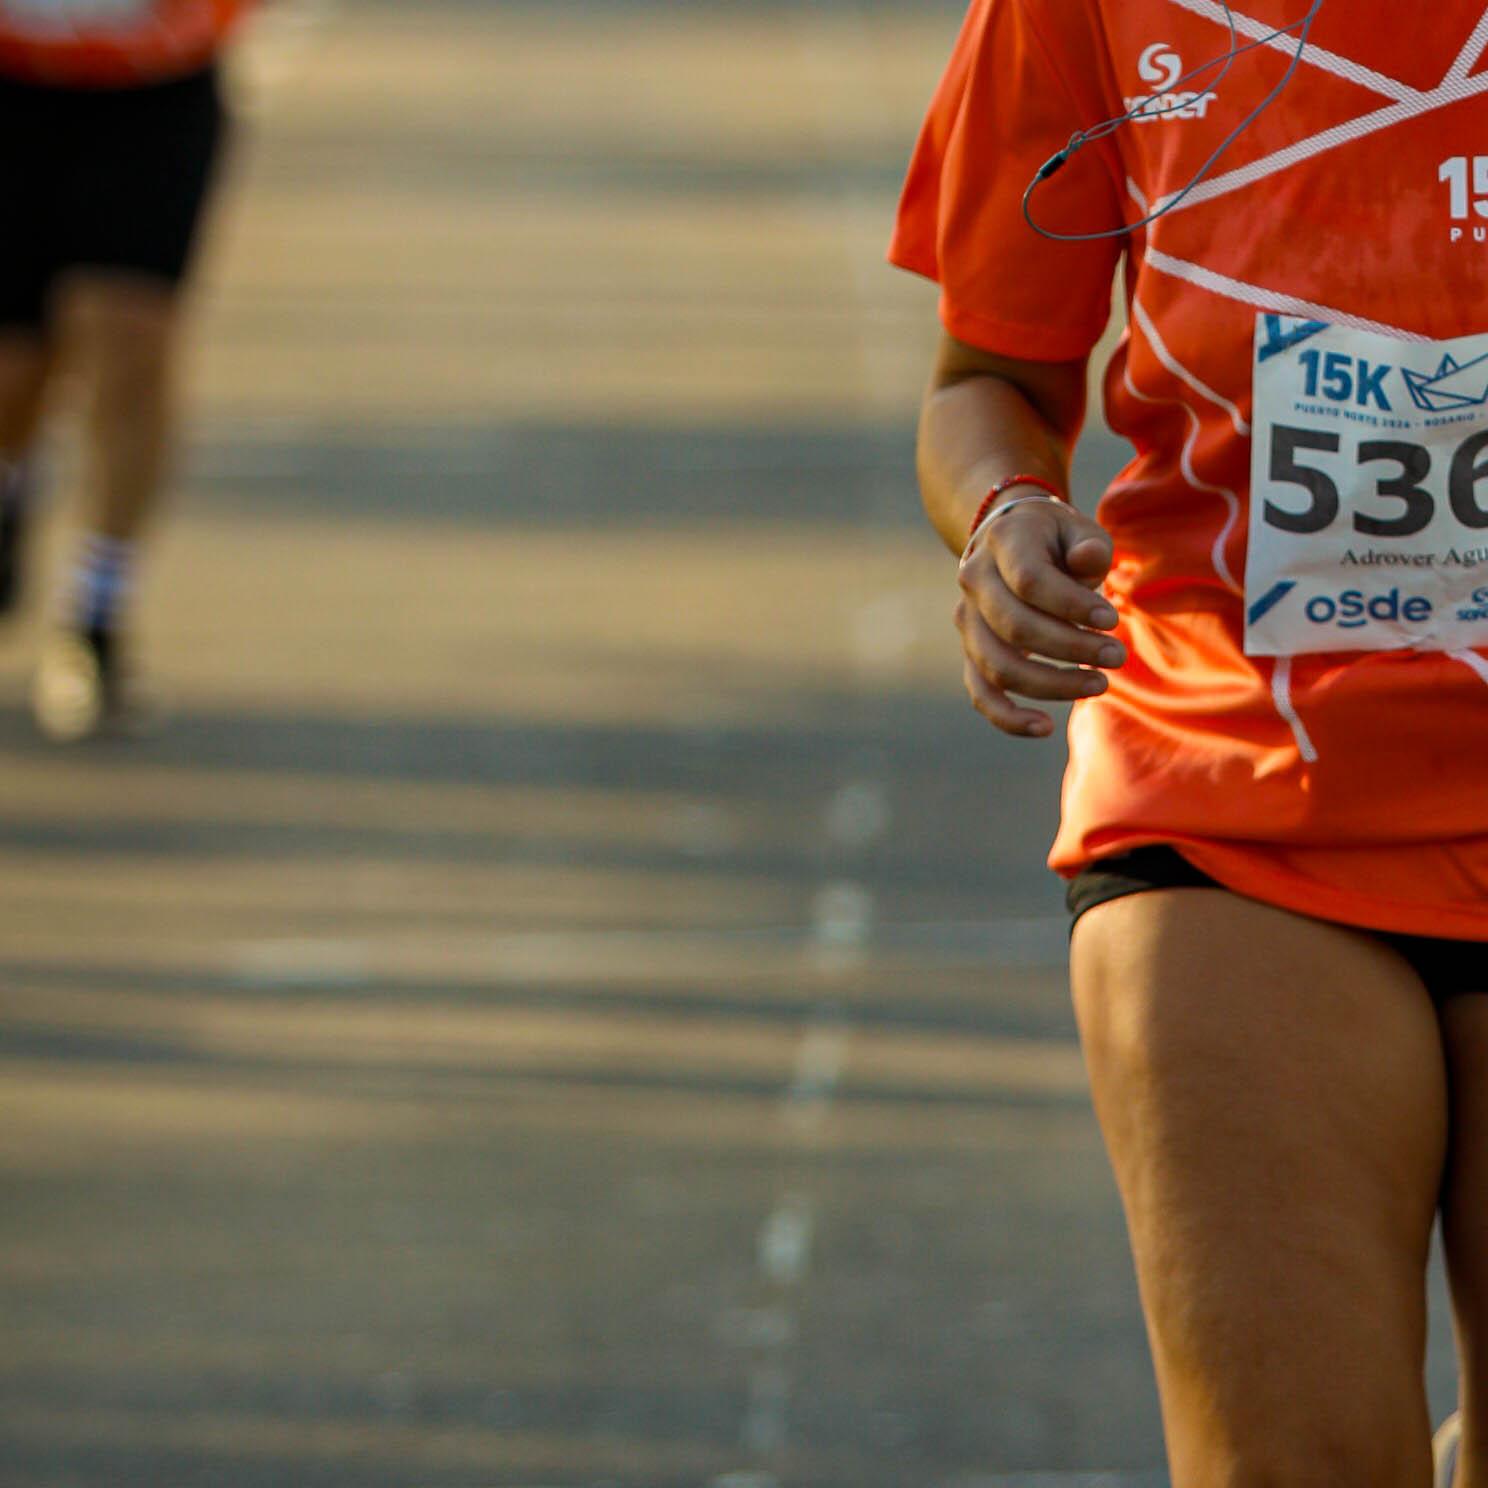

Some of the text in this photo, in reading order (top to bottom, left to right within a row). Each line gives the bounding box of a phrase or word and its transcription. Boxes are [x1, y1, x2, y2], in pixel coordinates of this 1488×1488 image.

[1298, 348, 1393, 411] 15K
[1294, 401, 1339, 417] PUERTO
[1344, 409, 1377, 427] NORTE
[1424, 412, 1476, 427] ROSARIO
[1340, 548, 1436, 567] Adrover
[1305, 588, 1433, 624] osde
